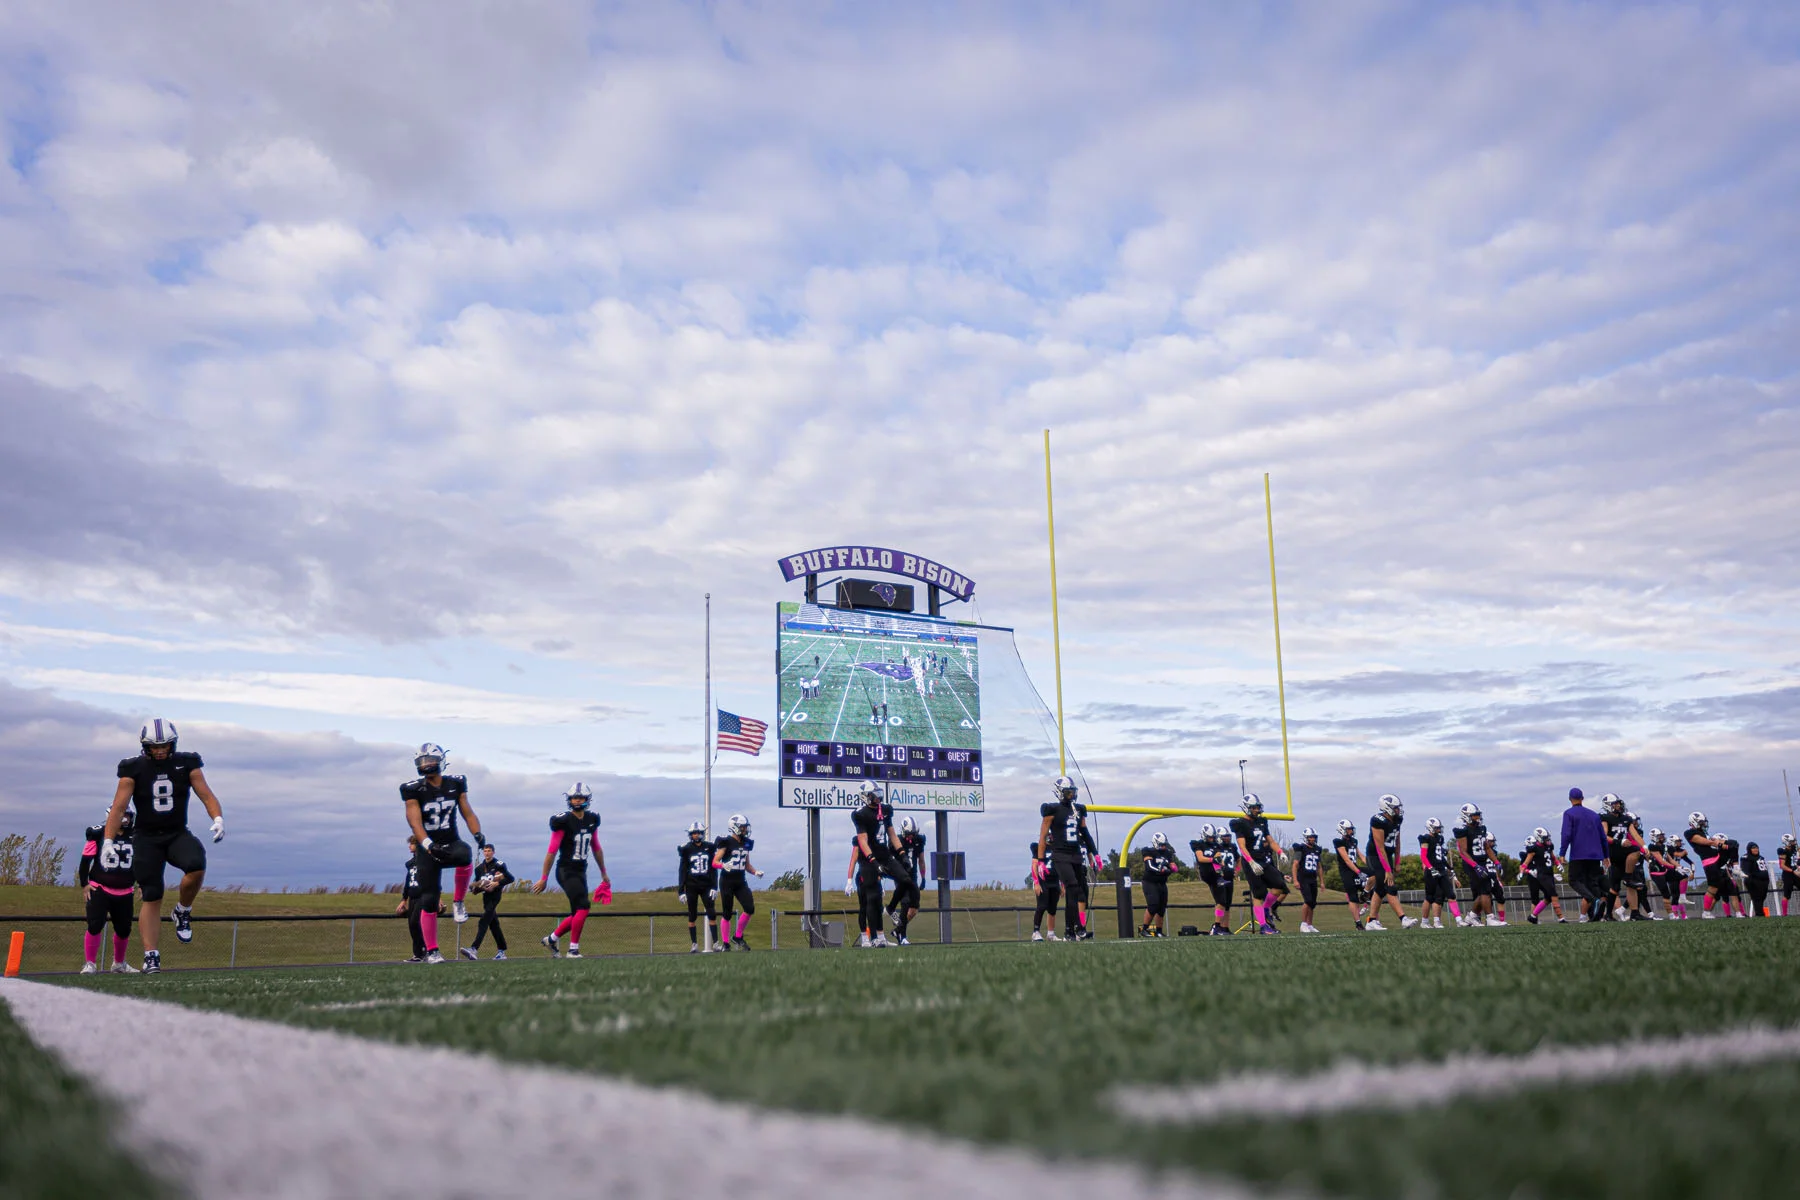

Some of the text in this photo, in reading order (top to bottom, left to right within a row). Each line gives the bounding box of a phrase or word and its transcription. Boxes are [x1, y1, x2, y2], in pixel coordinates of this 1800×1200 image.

[788, 548, 969, 596] BUFFALO BISON
[797, 744, 818, 755] HOME
[836, 745, 859, 757] 3 T.O.L.
[912, 749, 934, 762] T.O.L. 3
[947, 751, 970, 762] GUEST
[794, 759, 803, 775] 0
[816, 765, 833, 773] DOWN
[846, 766, 861, 774] TO GO
[932, 768, 948, 779] 1 QTR
[972, 767, 980, 782] 0
[153, 779, 174, 812] 8
[793, 787, 864, 806] Stellis Hea
[890, 788, 967, 806] Allina Health
[423, 800, 456, 831] 37
[876, 824, 885, 843] 4
[1066, 819, 1077, 841] 2
[572, 833, 592, 860] 10
[1253, 830, 1263, 850] 7
[690, 854, 709, 874] 30
[1220, 853, 1235, 869] 73
[1304, 855, 1319, 870] 65
[1543, 852, 1552, 867] 3
